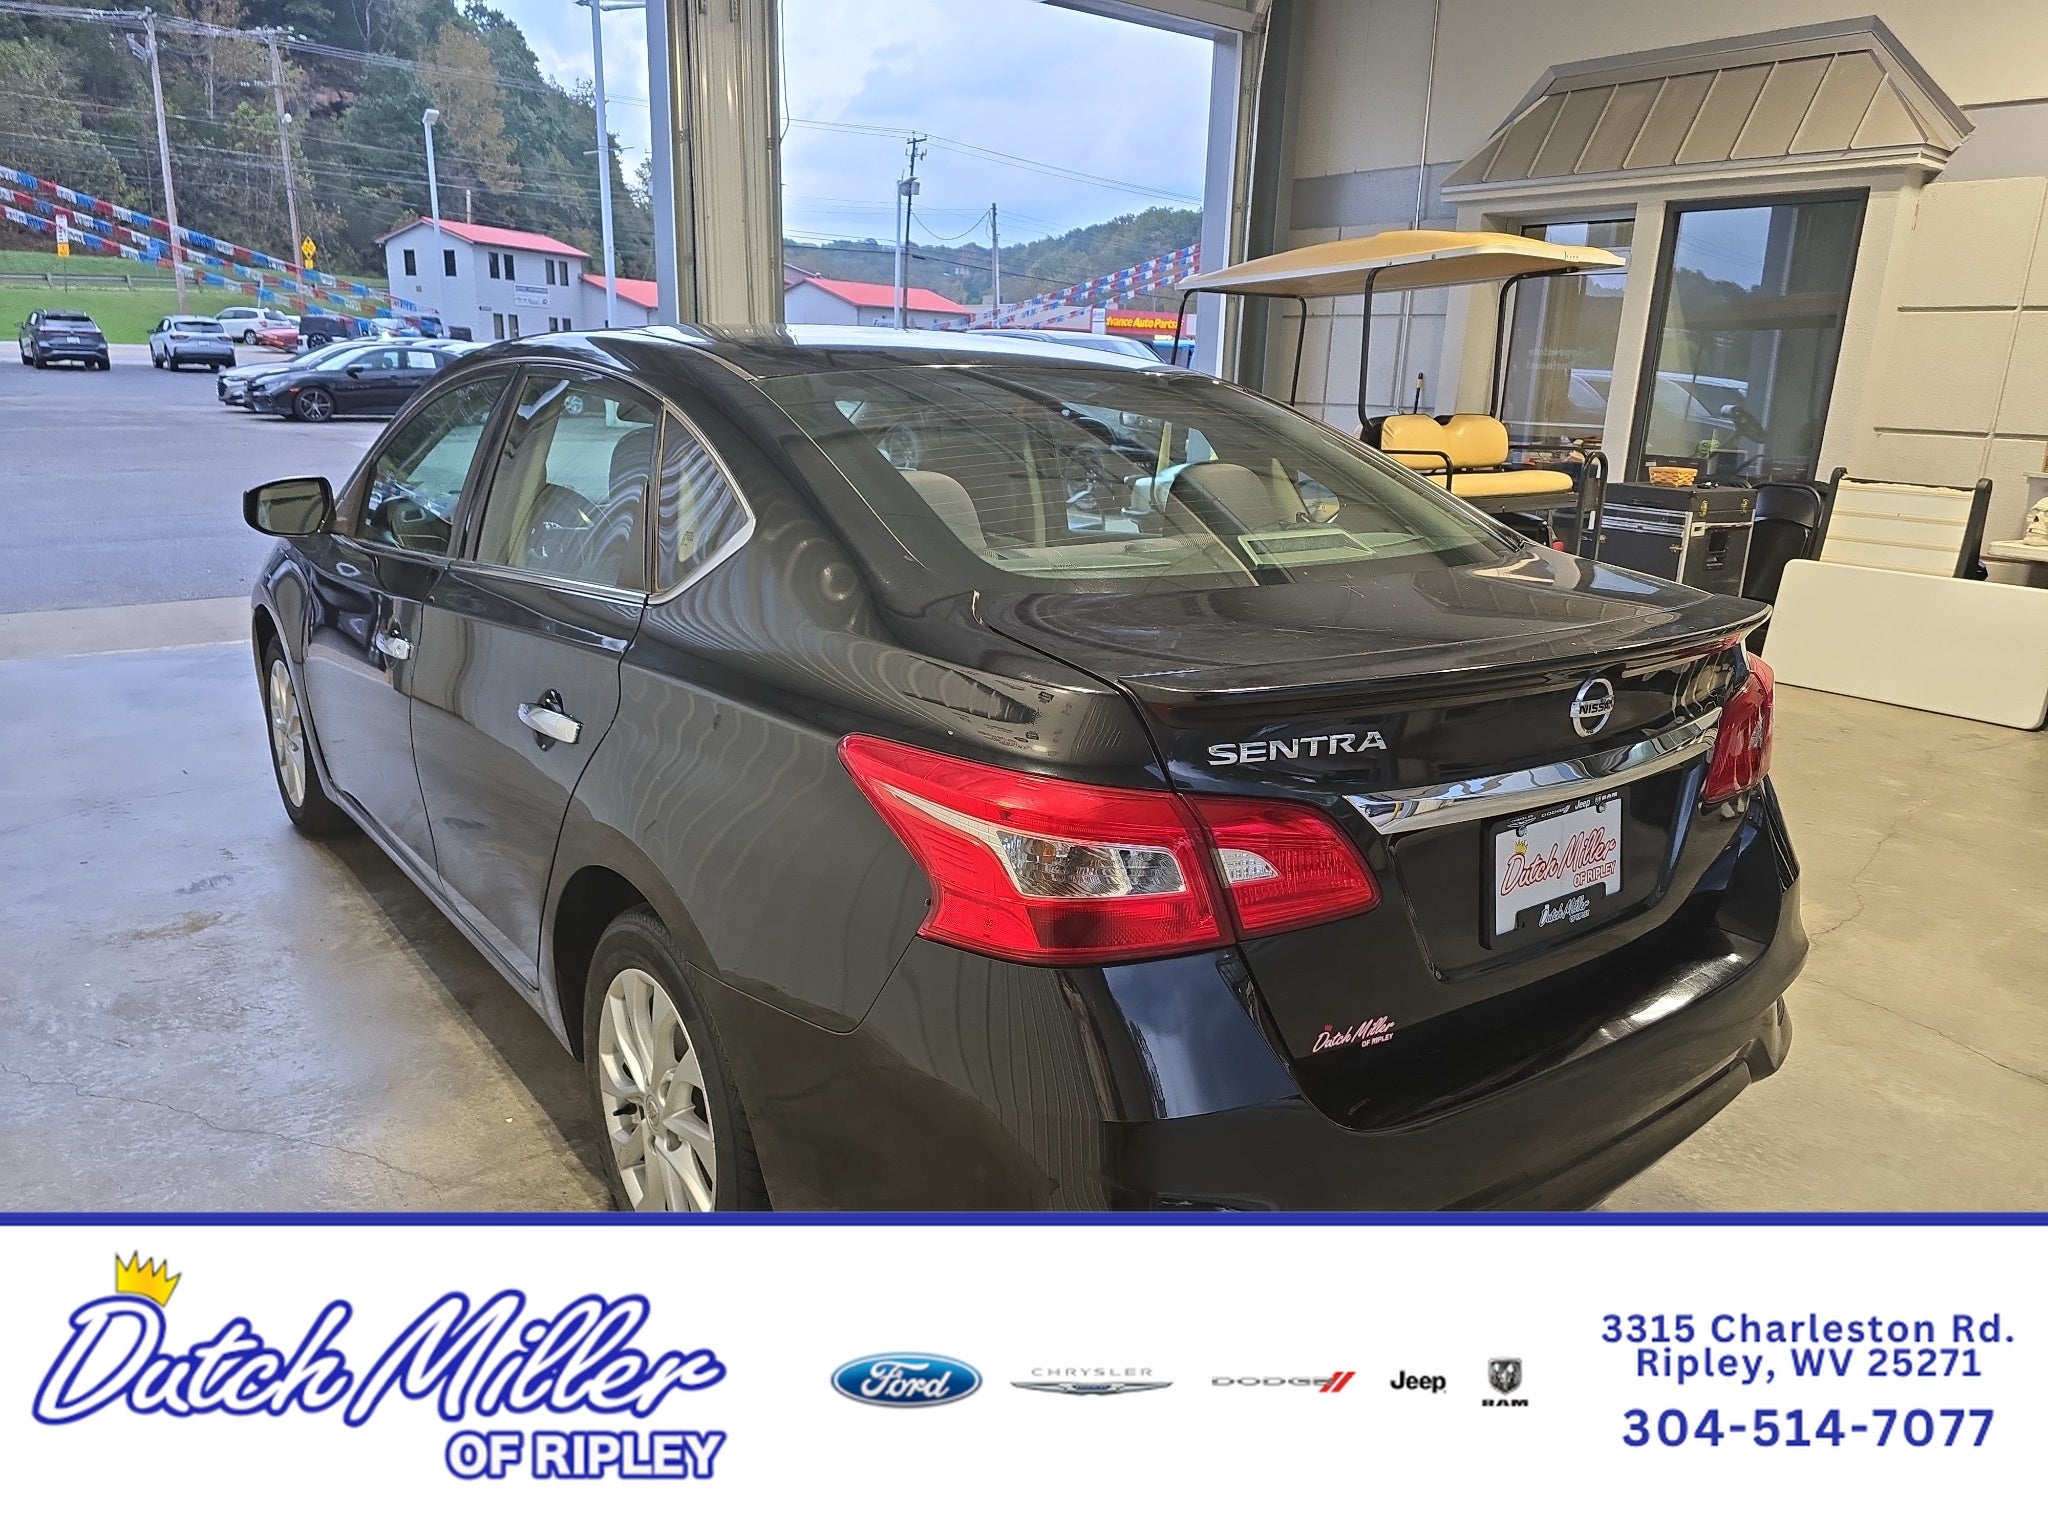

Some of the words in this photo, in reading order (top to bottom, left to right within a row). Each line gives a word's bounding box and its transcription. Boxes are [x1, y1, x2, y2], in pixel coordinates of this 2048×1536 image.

[1133, 318, 1155, 328] Auto
[1207, 731, 1388, 766] SENTRA
[1574, 799, 1591, 810] Jeep
[1601, 791, 1618, 801] RAM
[1500, 843, 1559, 896] Dutch
[1556, 826, 1617, 880] Miller
[1573, 872, 1586, 888] OF
[1586, 860, 1617, 884] RIPLEY
[1312, 1025, 1353, 1053] Dutch
[1350, 1015, 1395, 1043] Miller
[1361, 1039, 1371, 1048] OF
[1371, 1033, 1394, 1045] RIPLEY
